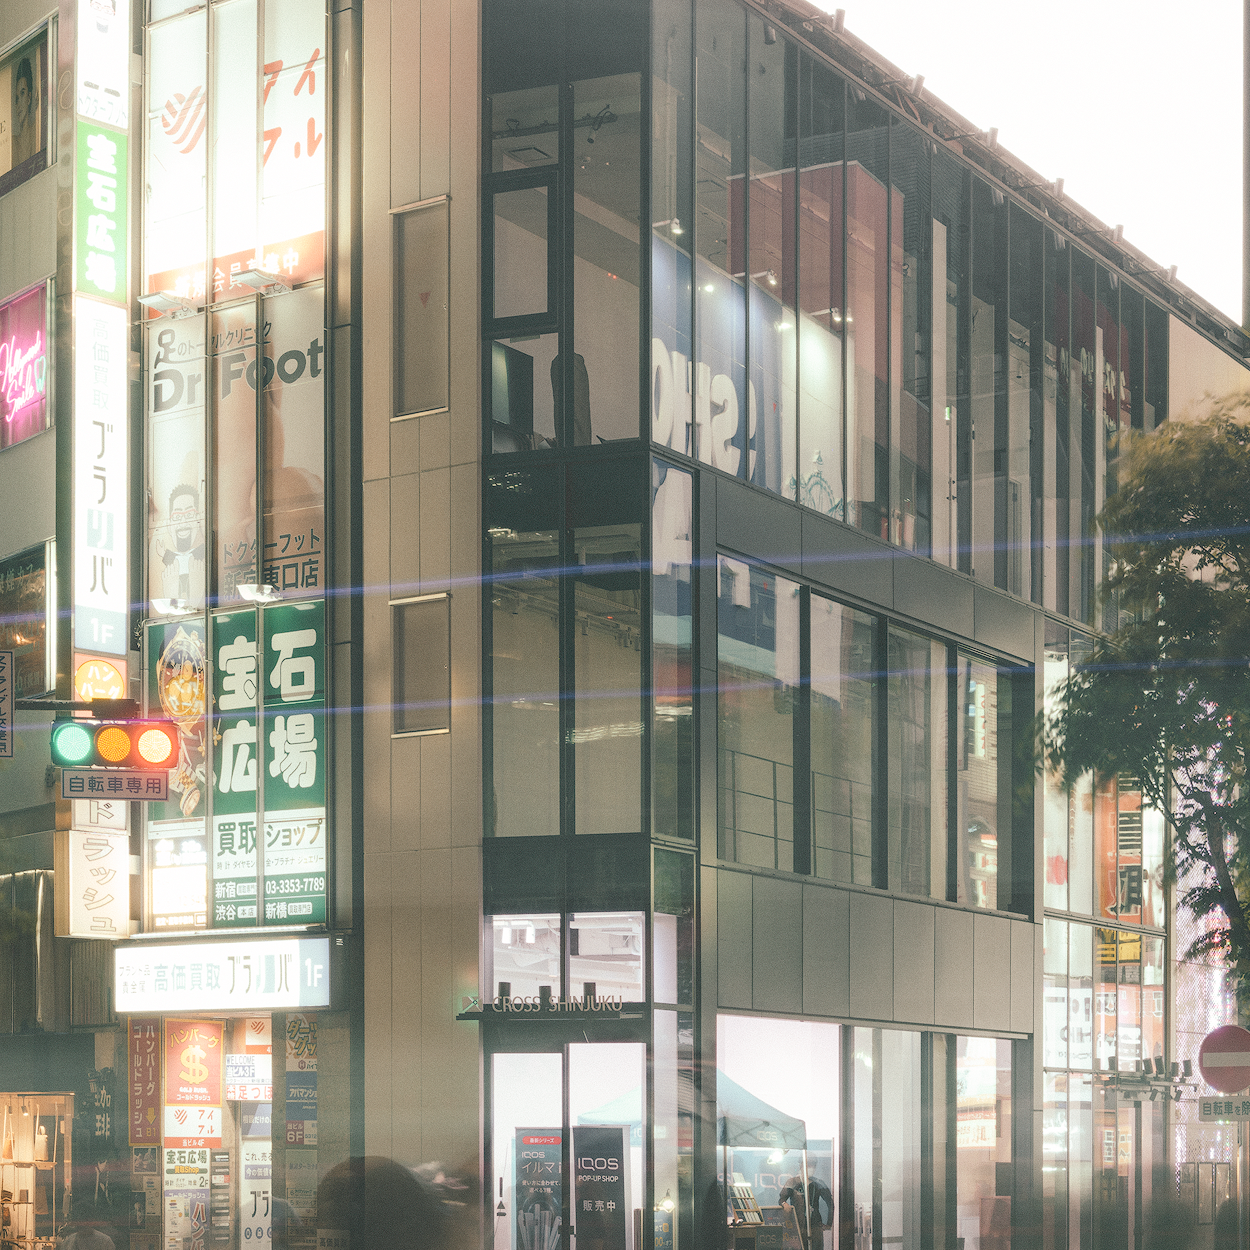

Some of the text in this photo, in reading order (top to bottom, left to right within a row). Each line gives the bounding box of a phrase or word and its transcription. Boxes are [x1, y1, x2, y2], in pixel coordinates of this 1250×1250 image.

[154, 337, 324, 413] Dr Foot
[90, 617, 114, 644] 1F
[218, 627, 317, 711] 宝石
[218, 712, 318, 794] 広場
[69, 776, 162, 794] 自転車専用
[216, 882, 236, 898] 新宿
[265, 877, 325, 895] 03-3353-7789
[154, 963, 221, 992] 高価買取
[304, 957, 324, 987] 1F
[492, 995, 622, 1012] CROSS SHINJUKU
[146, 1025, 156, 1096] ハンバーグ
[198, 1109, 214, 1120] アイ
[198, 1125, 214, 1135] フル
[286, 1131, 303, 1142] 6F
[166, 1149, 208, 1165] 宝石広場
[521, 1151, 546, 1159] IQOS
[521, 1161, 556, 1174] イルマ
[578, 1157, 619, 1172] IQOS
[199, 1176, 209, 1188] 2F
[578, 1174, 601, 1182] POP-UP
[582, 1199, 616, 1212] 販売中
